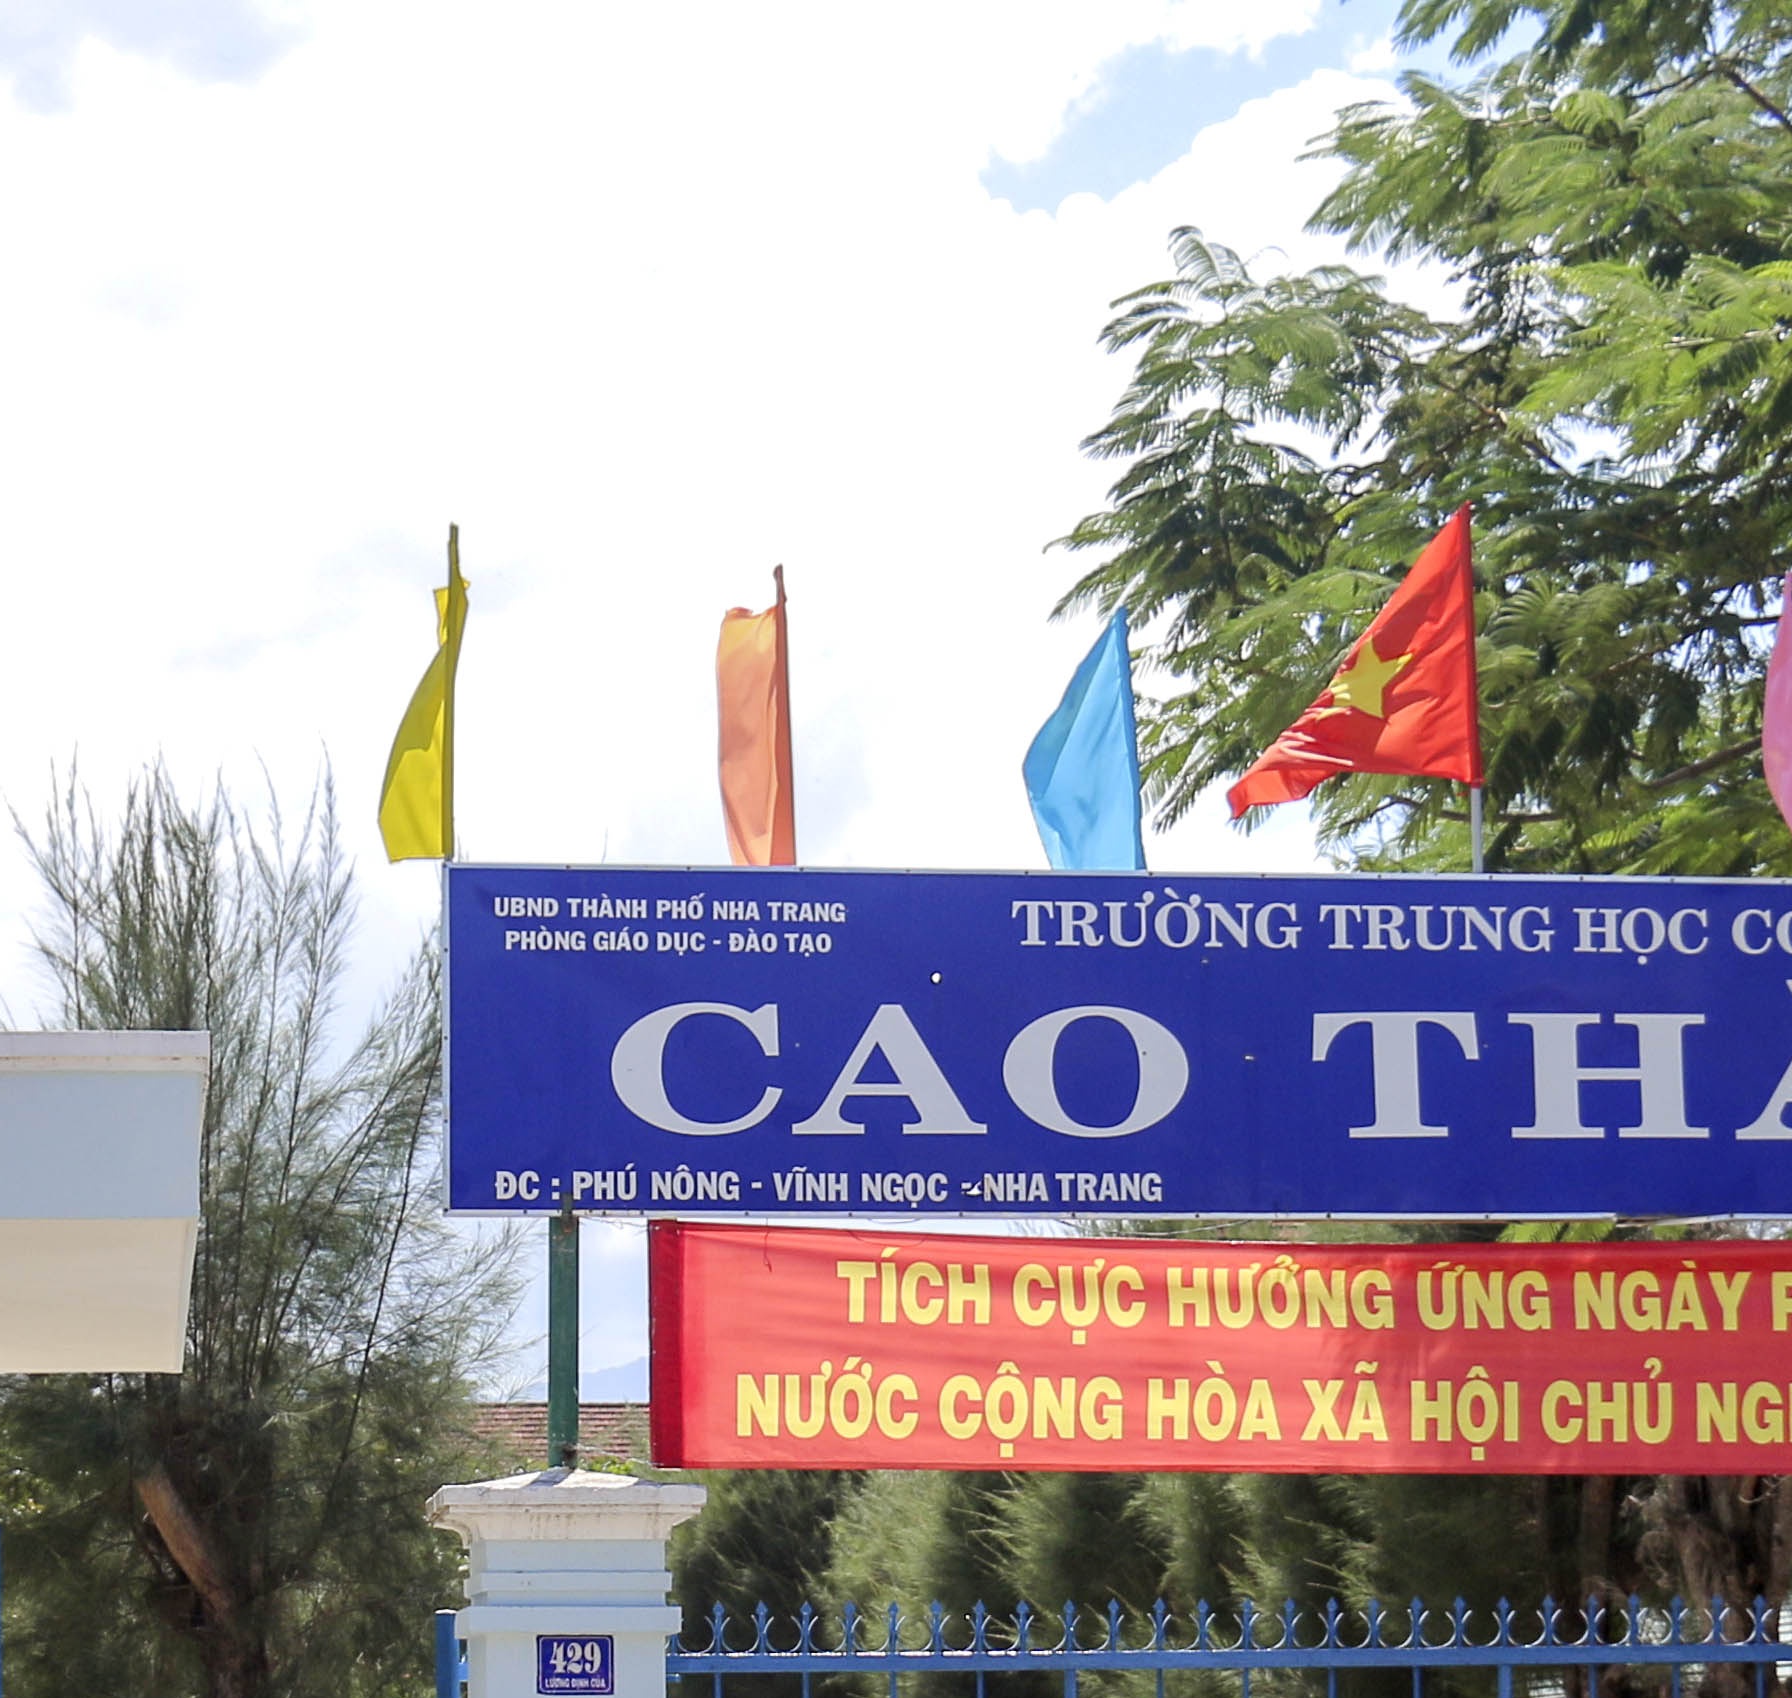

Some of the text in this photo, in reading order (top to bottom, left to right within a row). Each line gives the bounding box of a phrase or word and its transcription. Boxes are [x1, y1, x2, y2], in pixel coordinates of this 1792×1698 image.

[494, 893, 846, 922] UBND THÀNH PHỐ NHA TRANG
[1011, 887, 1302, 949] TRƯỜNG
[1319, 903, 1555, 953] TRUNG
[1573, 907, 1709, 965] HỌC
[505, 925, 586, 950] PHÒNG
[593, 926, 648, 951] GIÁO
[657, 932, 706, 956] DỤC
[728, 928, 778, 953] ĐÀO
[784, 932, 833, 956] TẠO
[610, 1000, 1190, 1139] CAO
[495, 1170, 540, 1201] ĐC
[572, 1162, 638, 1201] PHÚ
[651, 1164, 740, 1201] NÔNG
[772, 1166, 849, 1202] VĨNH
[861, 1172, 948, 1208] NGỌC
[983, 1172, 1049, 1202] NHA
[1055, 1172, 1163, 1202] TRANG
[836, 1247, 990, 1325] TÍCH
[1012, 1257, 1147, 1345] CỰC
[1166, 1253, 1396, 1330] HƯỞNG
[1416, 1261, 1553, 1330] ỨNG
[1573, 1260, 1752, 1332] NGÀY
[735, 1356, 920, 1440] NƯỚC
[938, 1360, 1124, 1458] CỘNG
[1146, 1360, 1282, 1442] HÒA
[1301, 1360, 1388, 1442] XÃ
[1410, 1365, 1520, 1461] HỘI
[1540, 1357, 1674, 1444] CHỦ
[549, 1641, 602, 1674] 429
